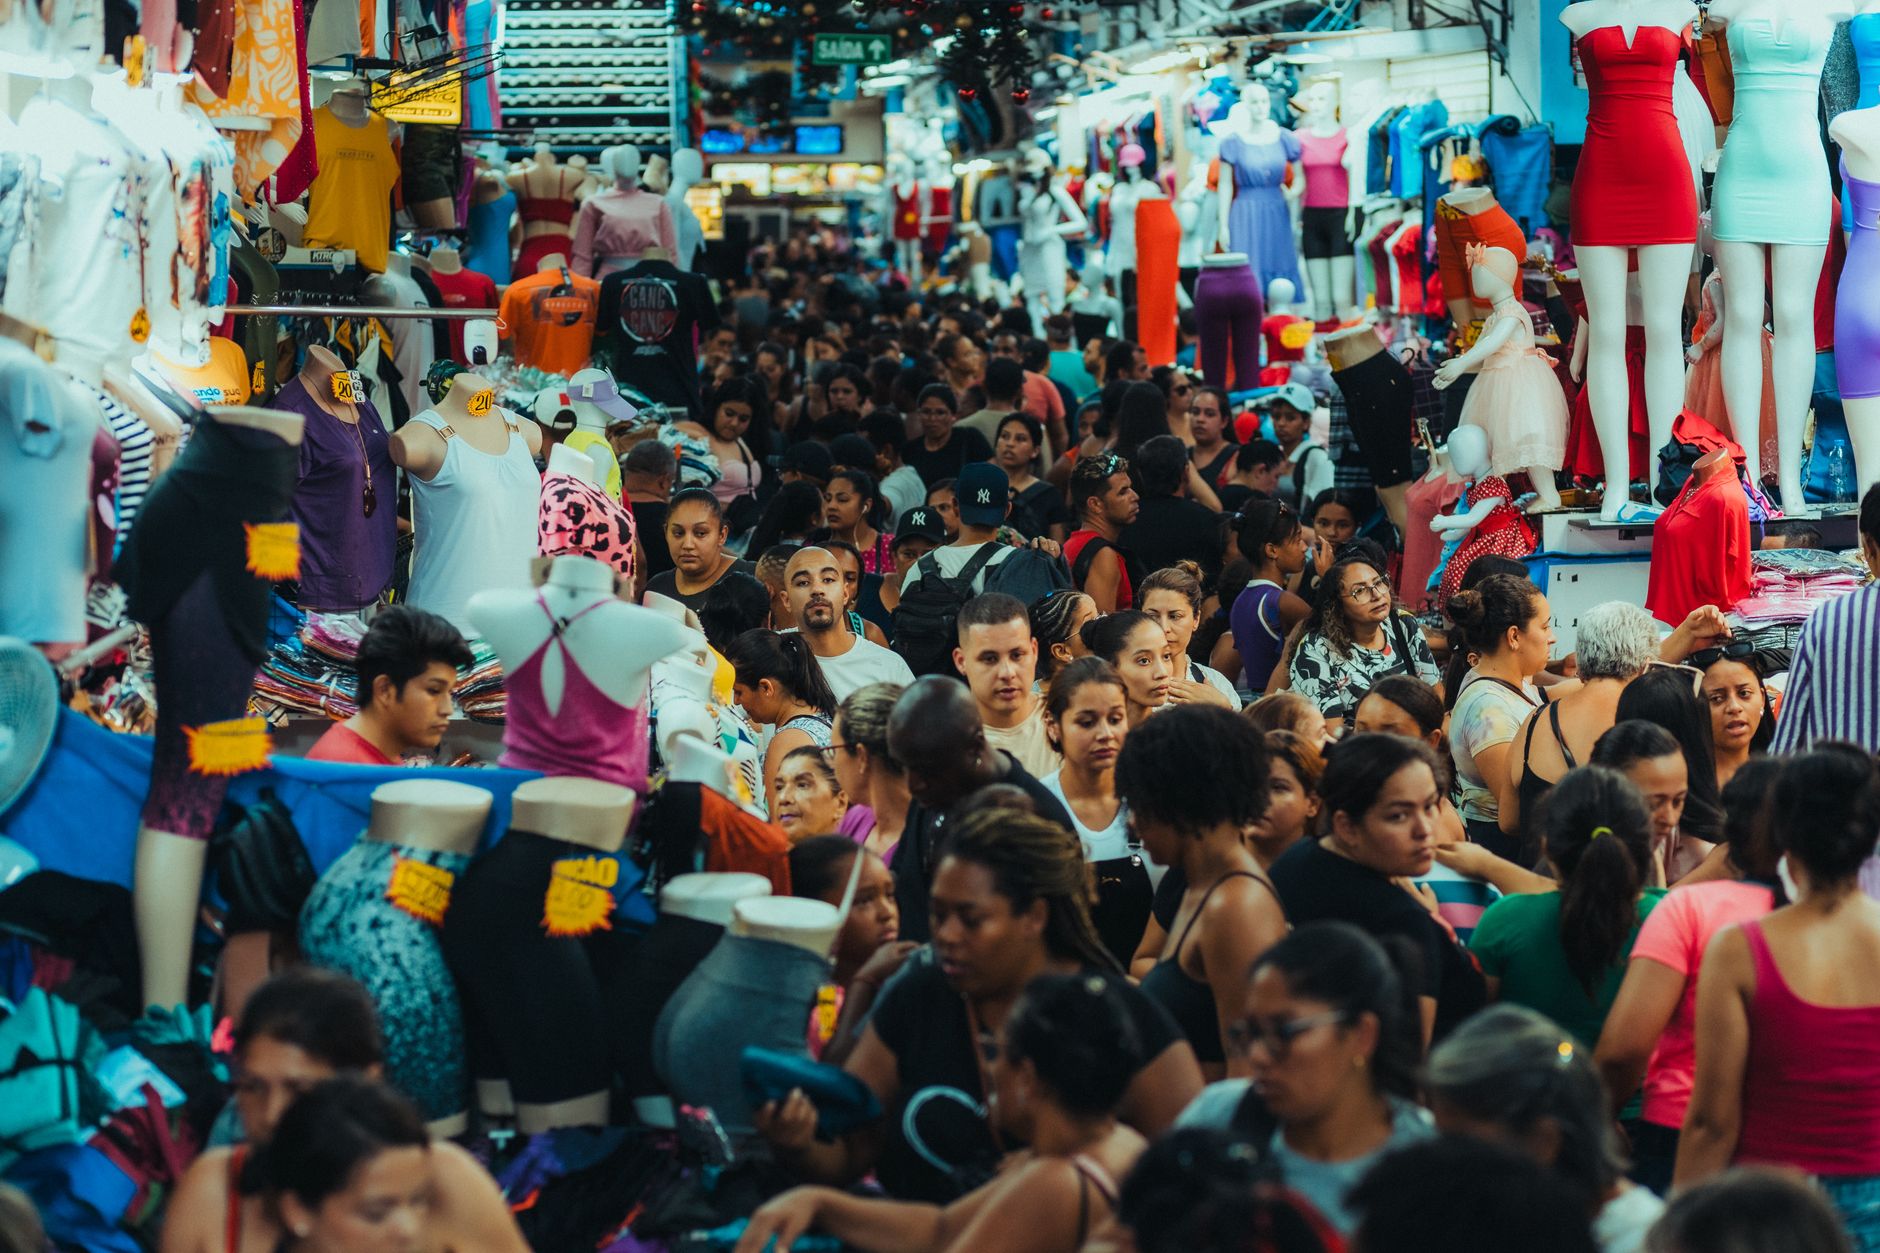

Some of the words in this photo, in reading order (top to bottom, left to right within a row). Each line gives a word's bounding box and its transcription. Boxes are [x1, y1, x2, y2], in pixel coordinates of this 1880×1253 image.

[818, 36, 865, 59] SAÍDA
[629, 285, 667, 309] GANG
[630, 311, 665, 334] GANG
[338, 380, 353, 398] 20
[475, 393, 492, 411] 20
[977, 487, 991, 504] NY
[911, 511, 926, 526] NY
